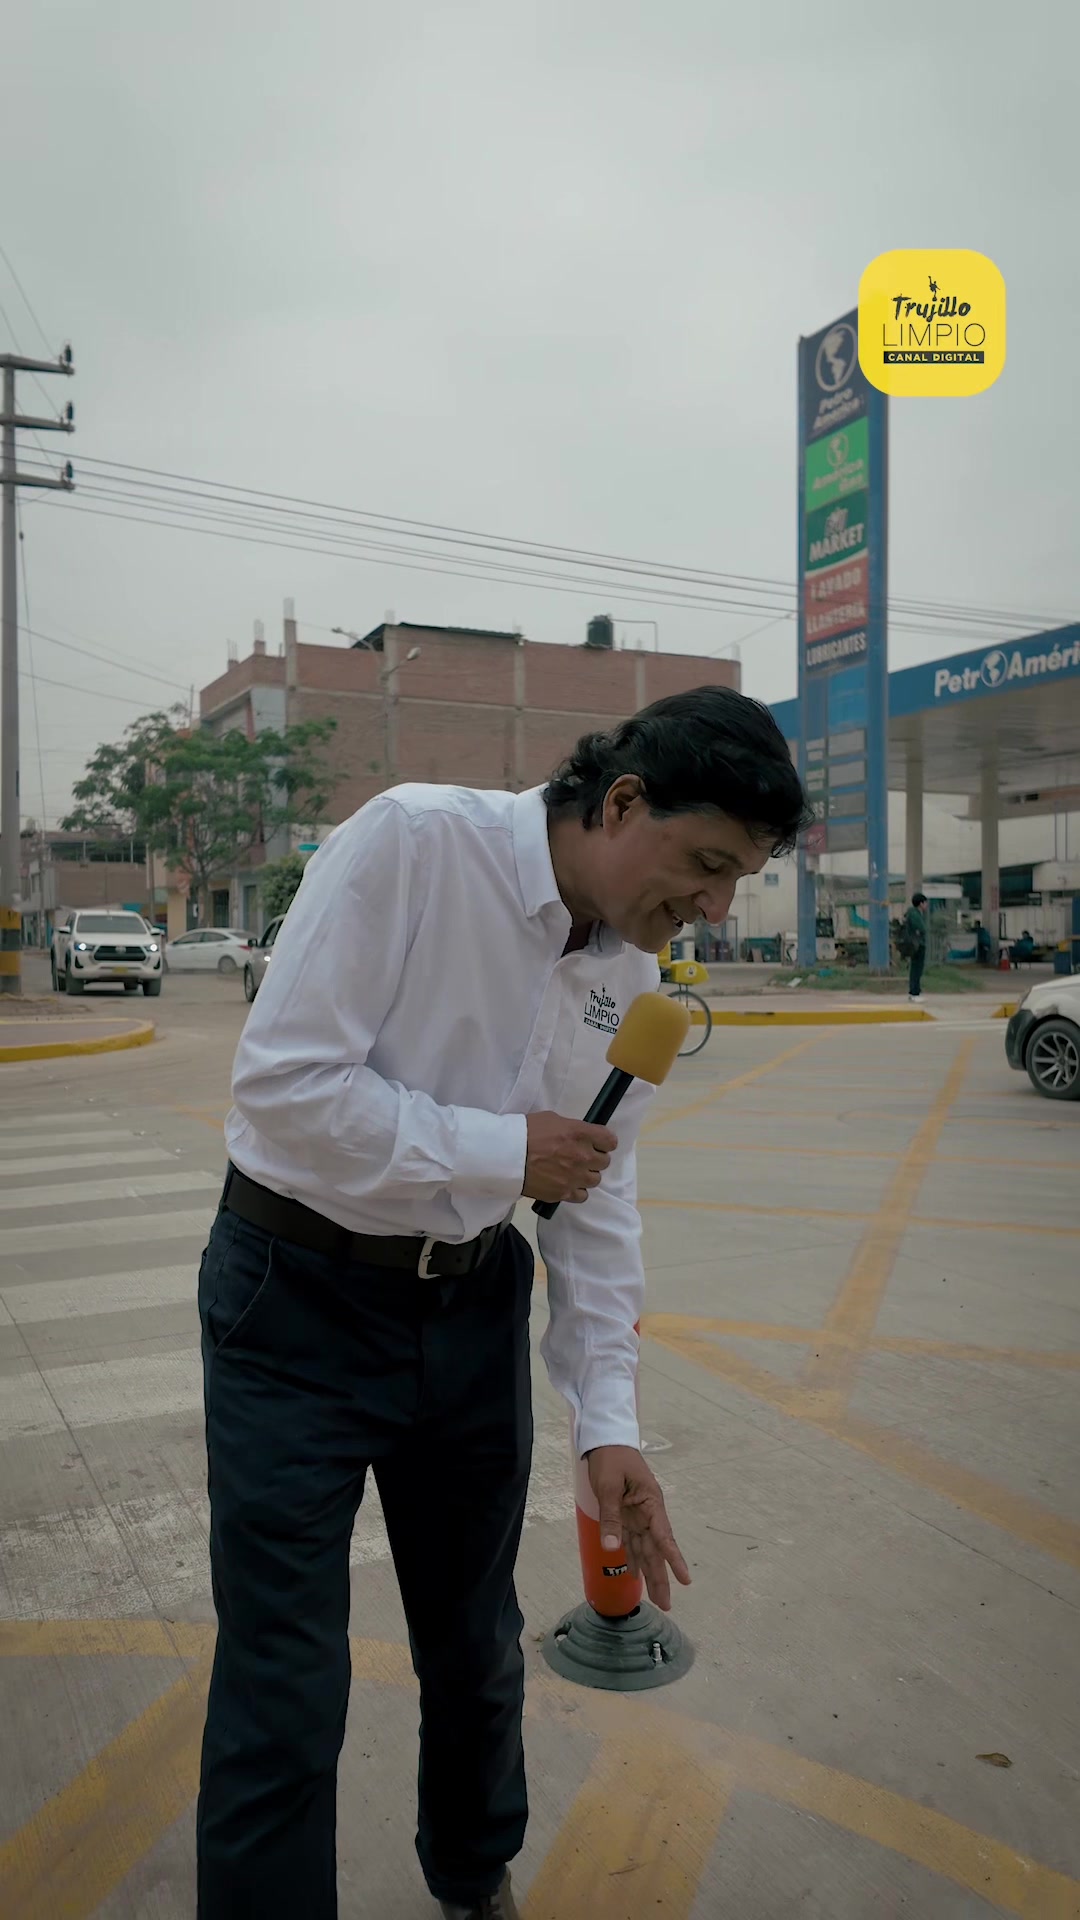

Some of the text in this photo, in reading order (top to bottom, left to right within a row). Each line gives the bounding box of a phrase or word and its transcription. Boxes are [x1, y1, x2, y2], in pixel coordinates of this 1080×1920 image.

[809, 521, 864, 562] MARKET
[807, 632, 866, 666] LUBRICANTES
[590, 989, 616, 1009] Trujillo
[584, 1002, 620, 1026] LIMPIO
